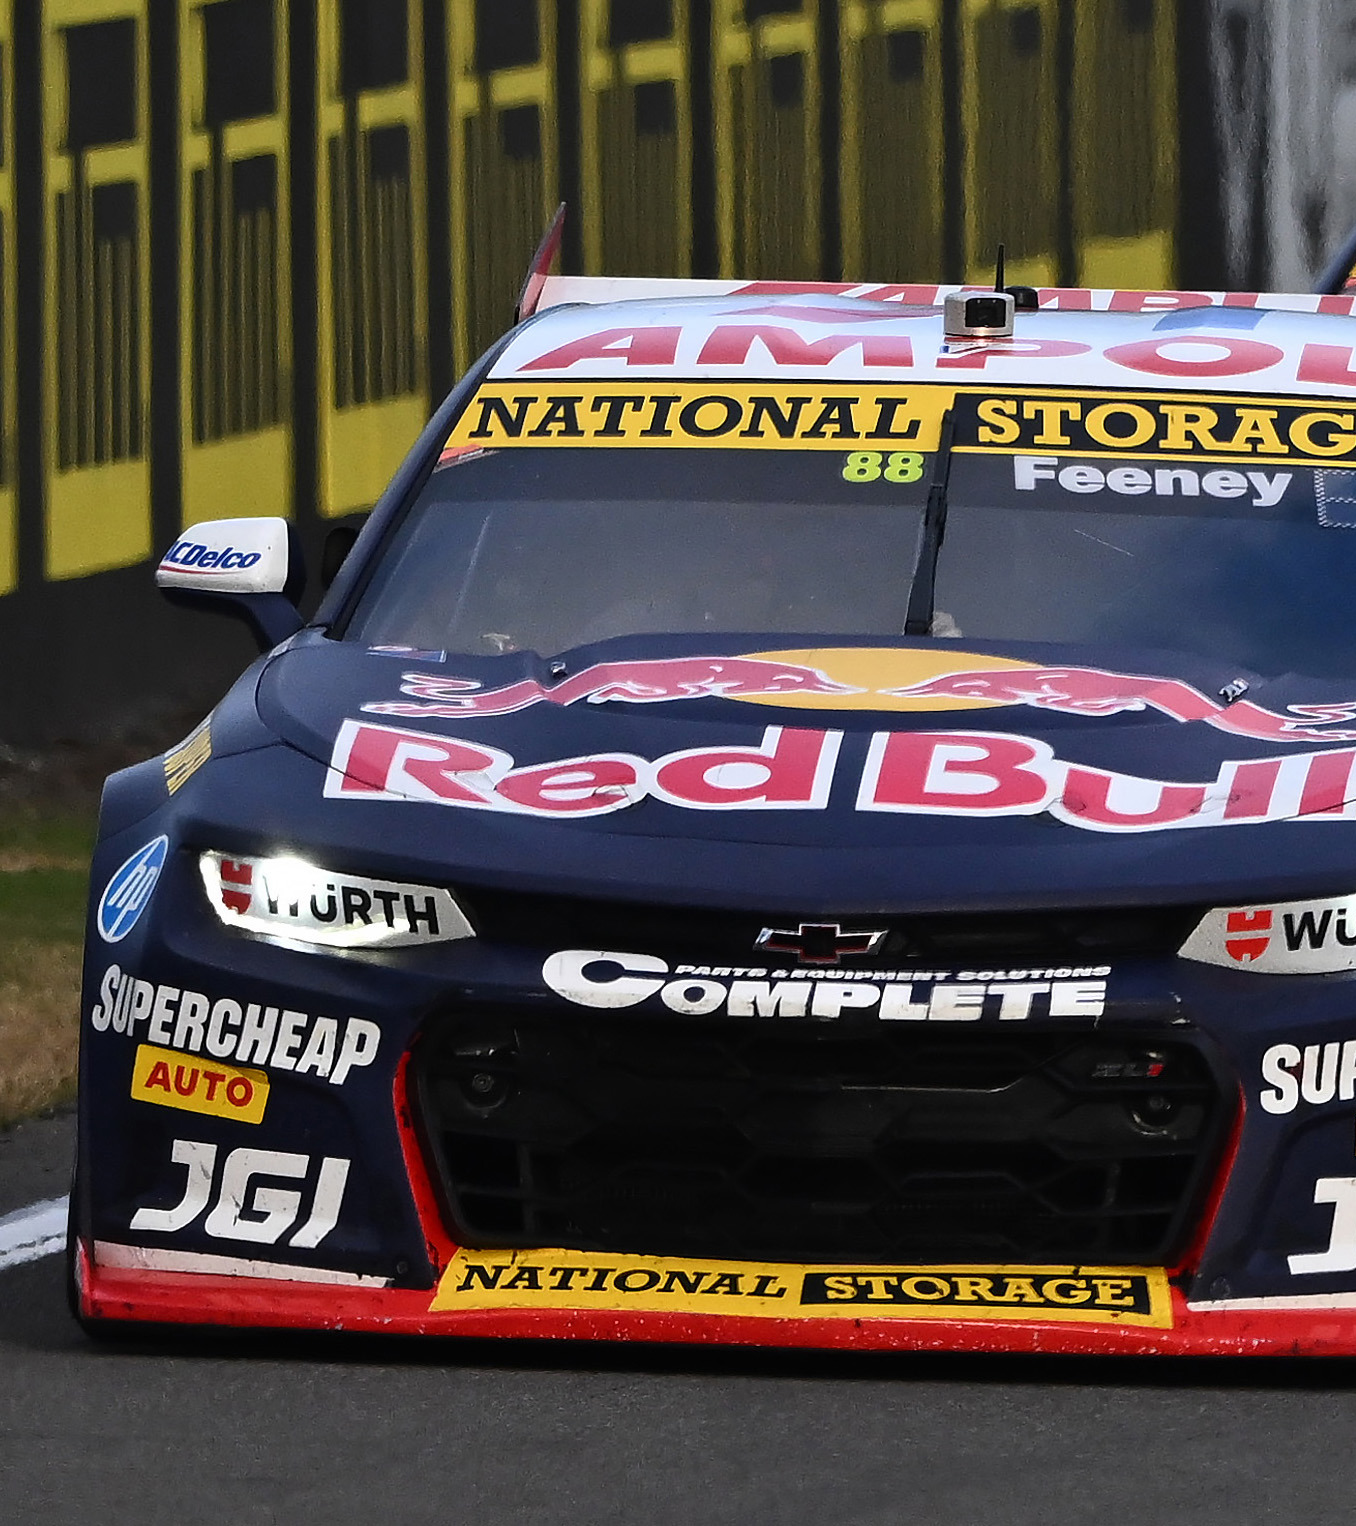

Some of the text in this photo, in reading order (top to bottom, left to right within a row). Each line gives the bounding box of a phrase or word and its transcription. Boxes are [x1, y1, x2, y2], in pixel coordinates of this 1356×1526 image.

[469, 395, 921, 439] NATIONAL
[842, 451, 925, 483] 88
[1013, 455, 1292, 507] Feeney
[323, 719, 844, 819] Red
[542, 949, 1108, 1021] COMPLETE
[92, 964, 381, 1085] SUPERCHEAP
[145, 1061, 254, 1107] AUTO
[130, 1139, 351, 1249] JGI
[457, 1264, 1136, 1307] NATIONAL STORAGE
